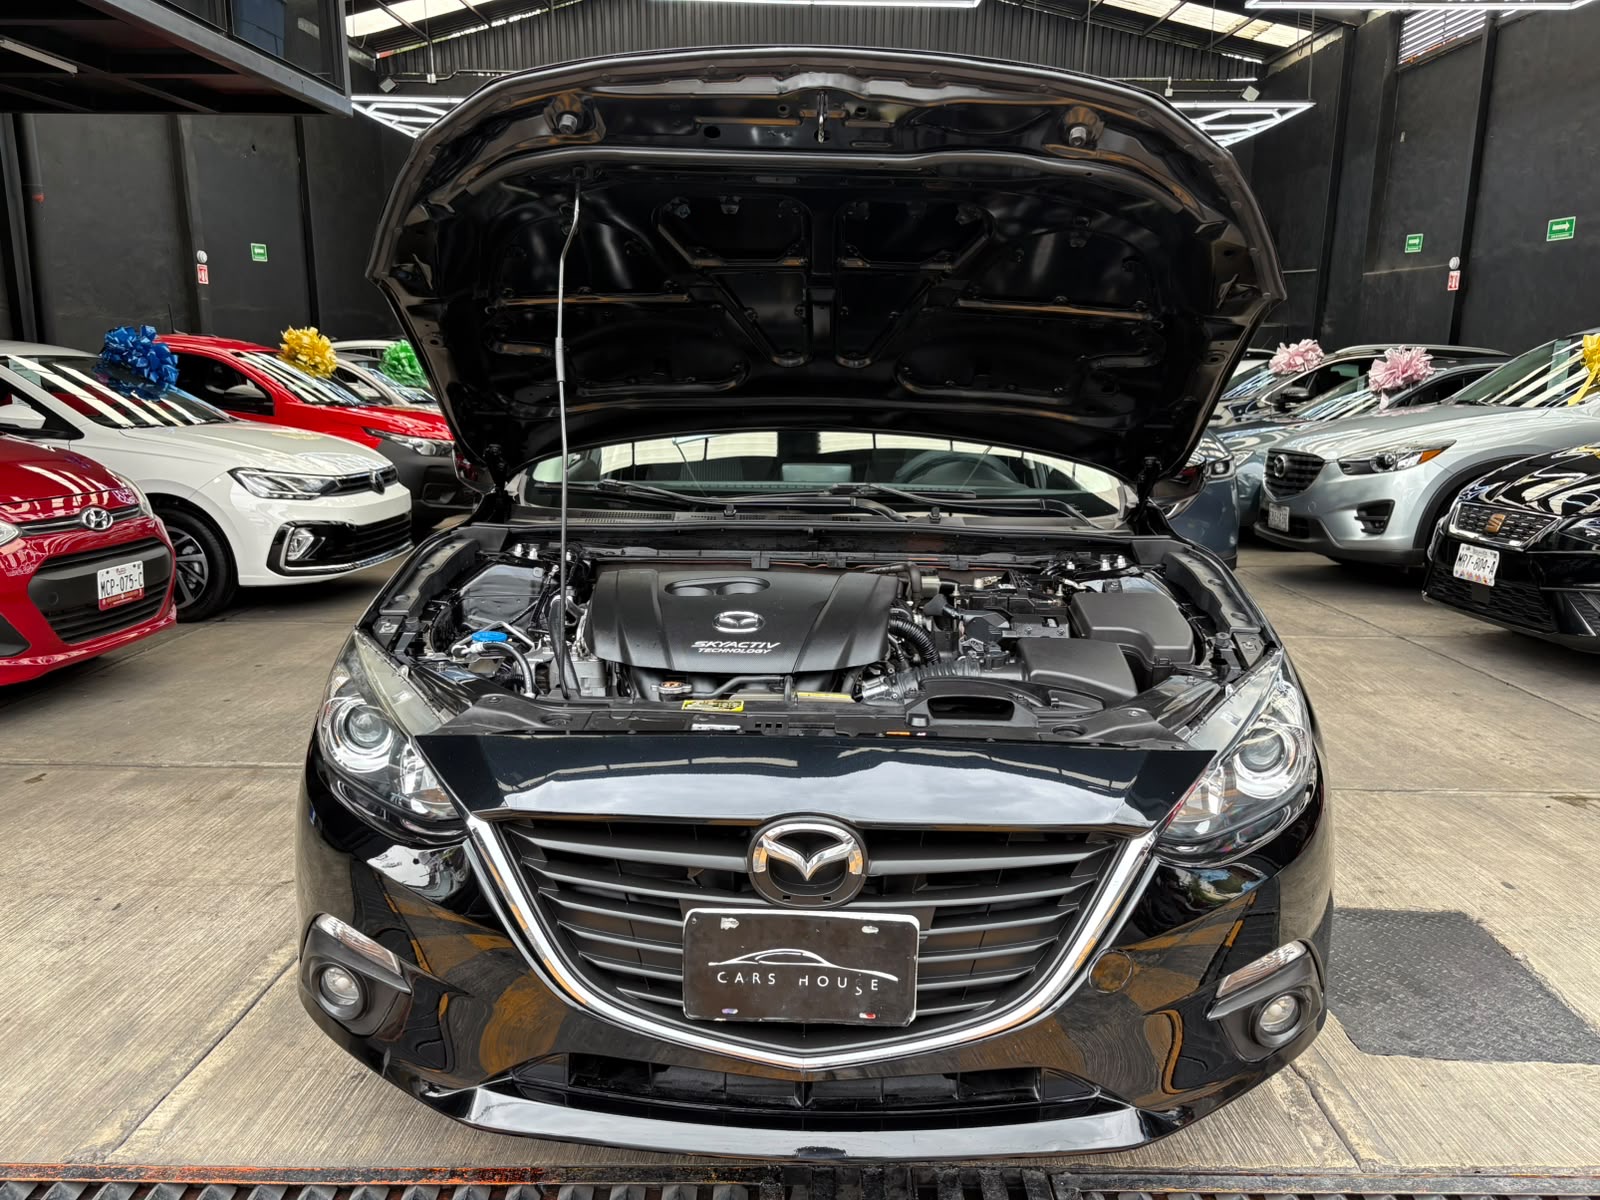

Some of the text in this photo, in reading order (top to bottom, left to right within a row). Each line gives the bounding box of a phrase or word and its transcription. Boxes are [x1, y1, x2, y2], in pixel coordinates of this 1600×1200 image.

[691, 640, 781, 649] SKYACTIV
[717, 971, 879, 995] CARS HOUSE
